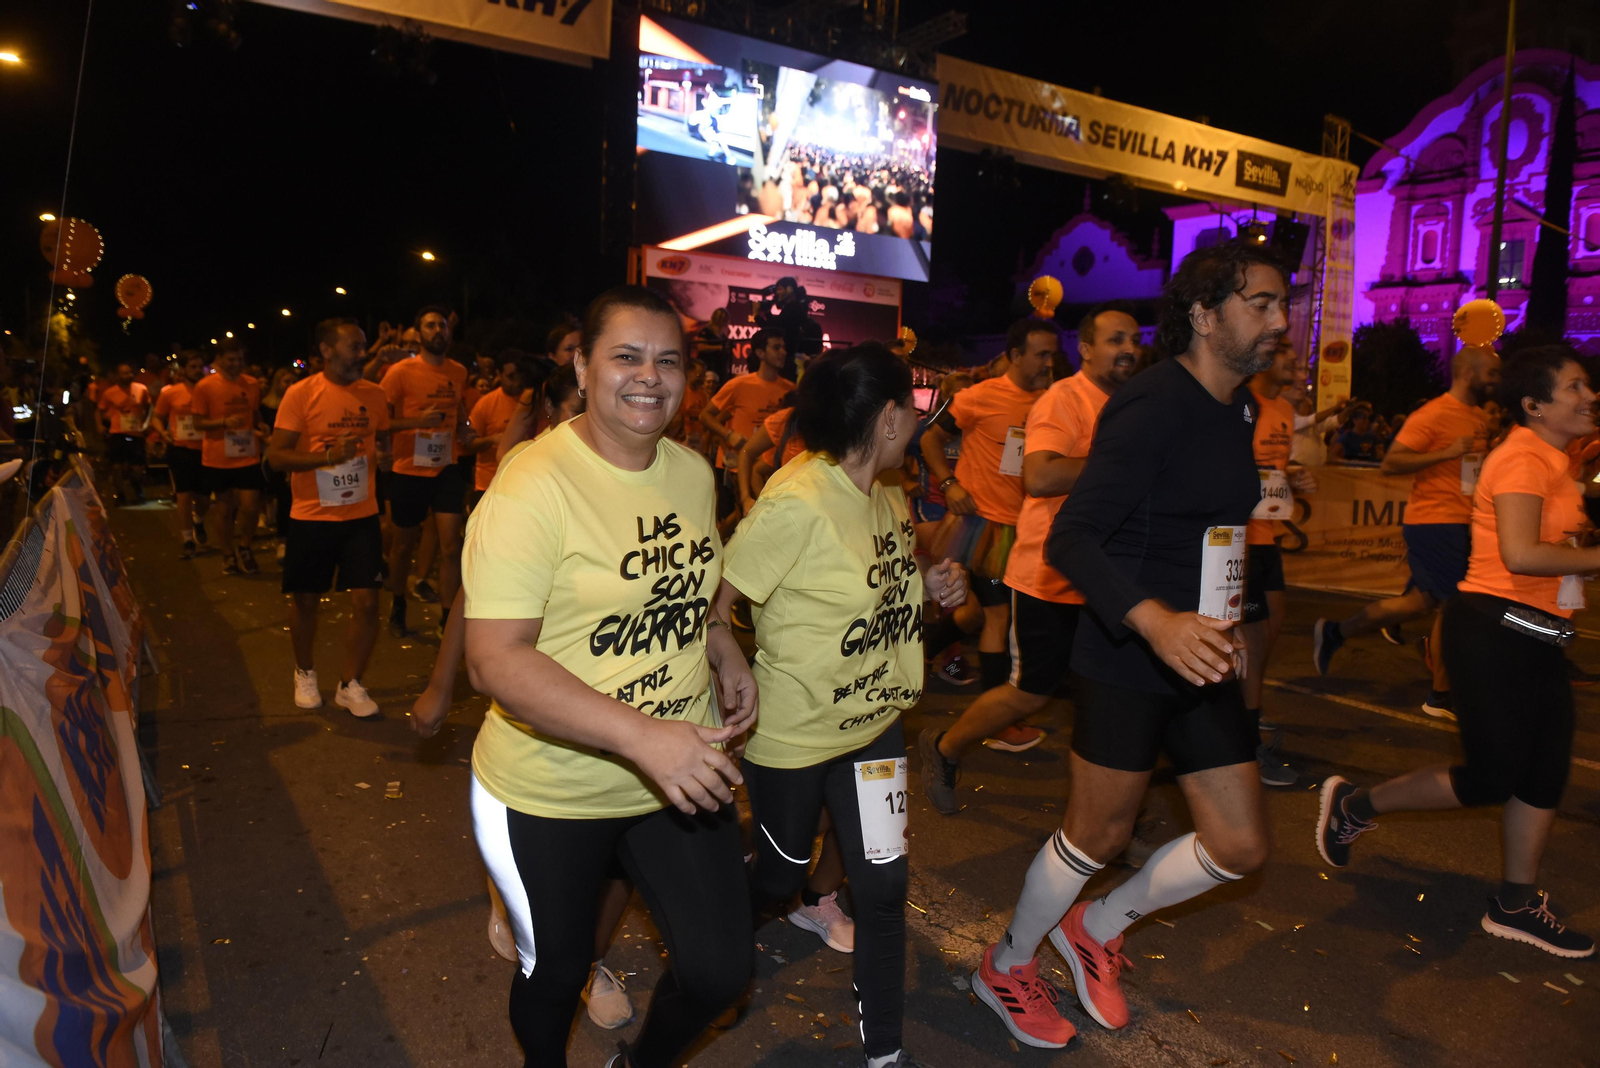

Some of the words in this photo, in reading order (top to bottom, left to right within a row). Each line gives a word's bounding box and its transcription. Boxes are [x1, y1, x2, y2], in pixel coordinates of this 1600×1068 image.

[943, 83, 1083, 142] NOCTURNA
[1087, 120, 1176, 164] SEVILLA
[333, 472, 360, 487] 6194
[1261, 486, 1289, 499] 14401
[636, 512, 682, 544] LAS
[872, 531, 898, 558] LAS
[619, 536, 715, 580] CHICAS
[866, 553, 918, 589] CHICAS
[643, 568, 706, 608] SON
[875, 579, 910, 611] SON
[833, 660, 889, 704] BEATRIZ
